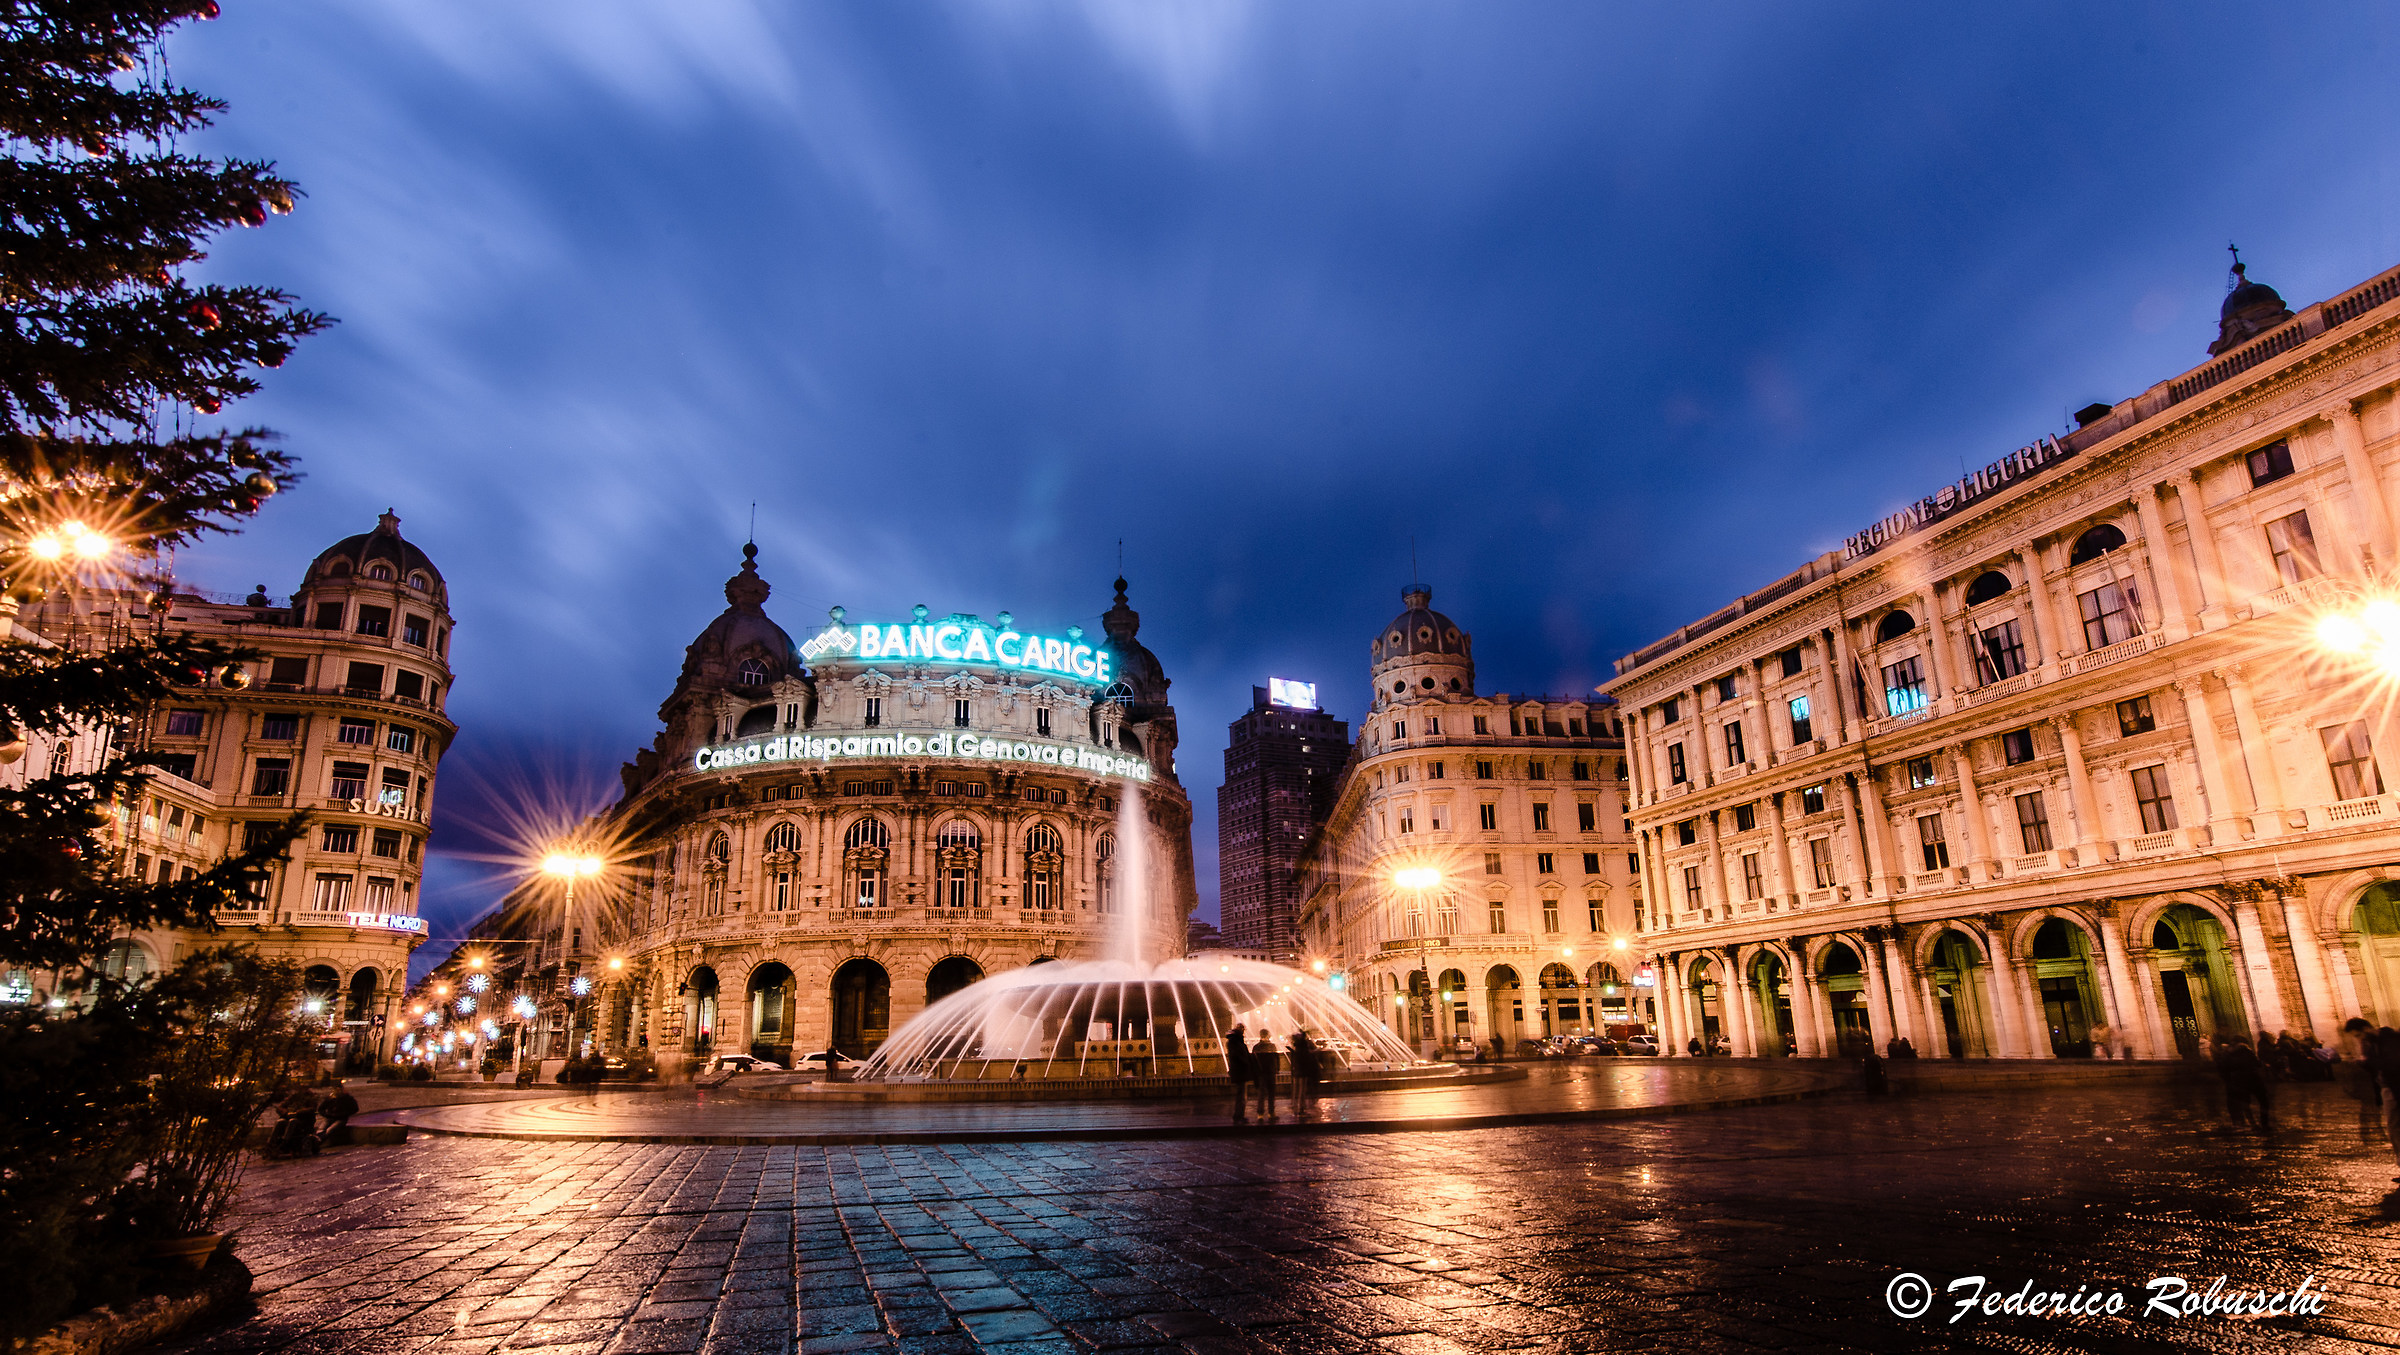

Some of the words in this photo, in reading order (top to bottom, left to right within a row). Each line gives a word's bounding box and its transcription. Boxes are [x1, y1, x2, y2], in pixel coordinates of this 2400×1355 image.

[1843, 495, 1936, 561] REGIONE
[1957, 432, 2063, 503] LIGURIA
[859, 624, 992, 661] BANCA
[995, 632, 1110, 683] CARIGE
[695, 744, 761, 770] Cassa
[764, 737, 787, 760] di
[788, 733, 923, 760] Risparmio
[927, 733, 952, 757] di
[956, 734, 1057, 764] Genova
[1060, 748, 1076, 765] e
[1078, 747, 1148, 780] Imperia
[348, 798, 416, 821] SUSHI
[347, 912, 390, 927] TELE
[390, 914, 421, 930] NORD
